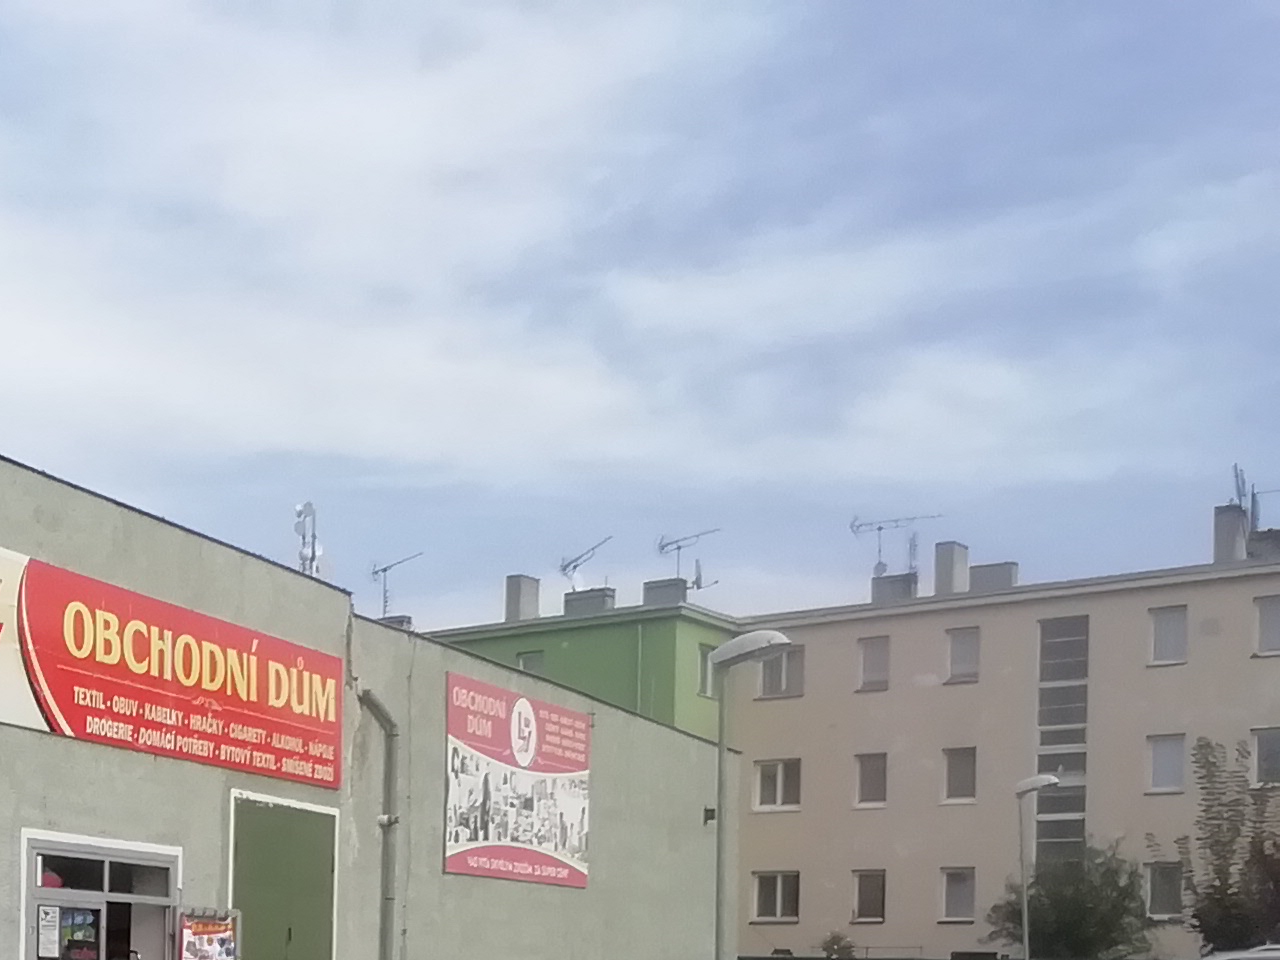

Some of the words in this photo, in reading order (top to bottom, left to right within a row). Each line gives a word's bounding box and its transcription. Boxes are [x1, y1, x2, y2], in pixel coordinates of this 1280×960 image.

[63, 601, 258, 702] OBCHODNÍ
[268, 656, 337, 723] DŮM
[73, 686, 106, 710] TEXTIL
[112, 695, 138, 717] OBUV
[144, 702, 184, 727] KABELKY
[189, 712, 225, 736] HRAČKY
[229, 722, 267, 745] CIGARETY
[86, 715, 134, 742] DROGERIE
[138, 727, 176, 750] DOMÁCÍ
[176, 734, 216, 759] POTŘEBY
[252, 751, 277, 771] TEXTIL
